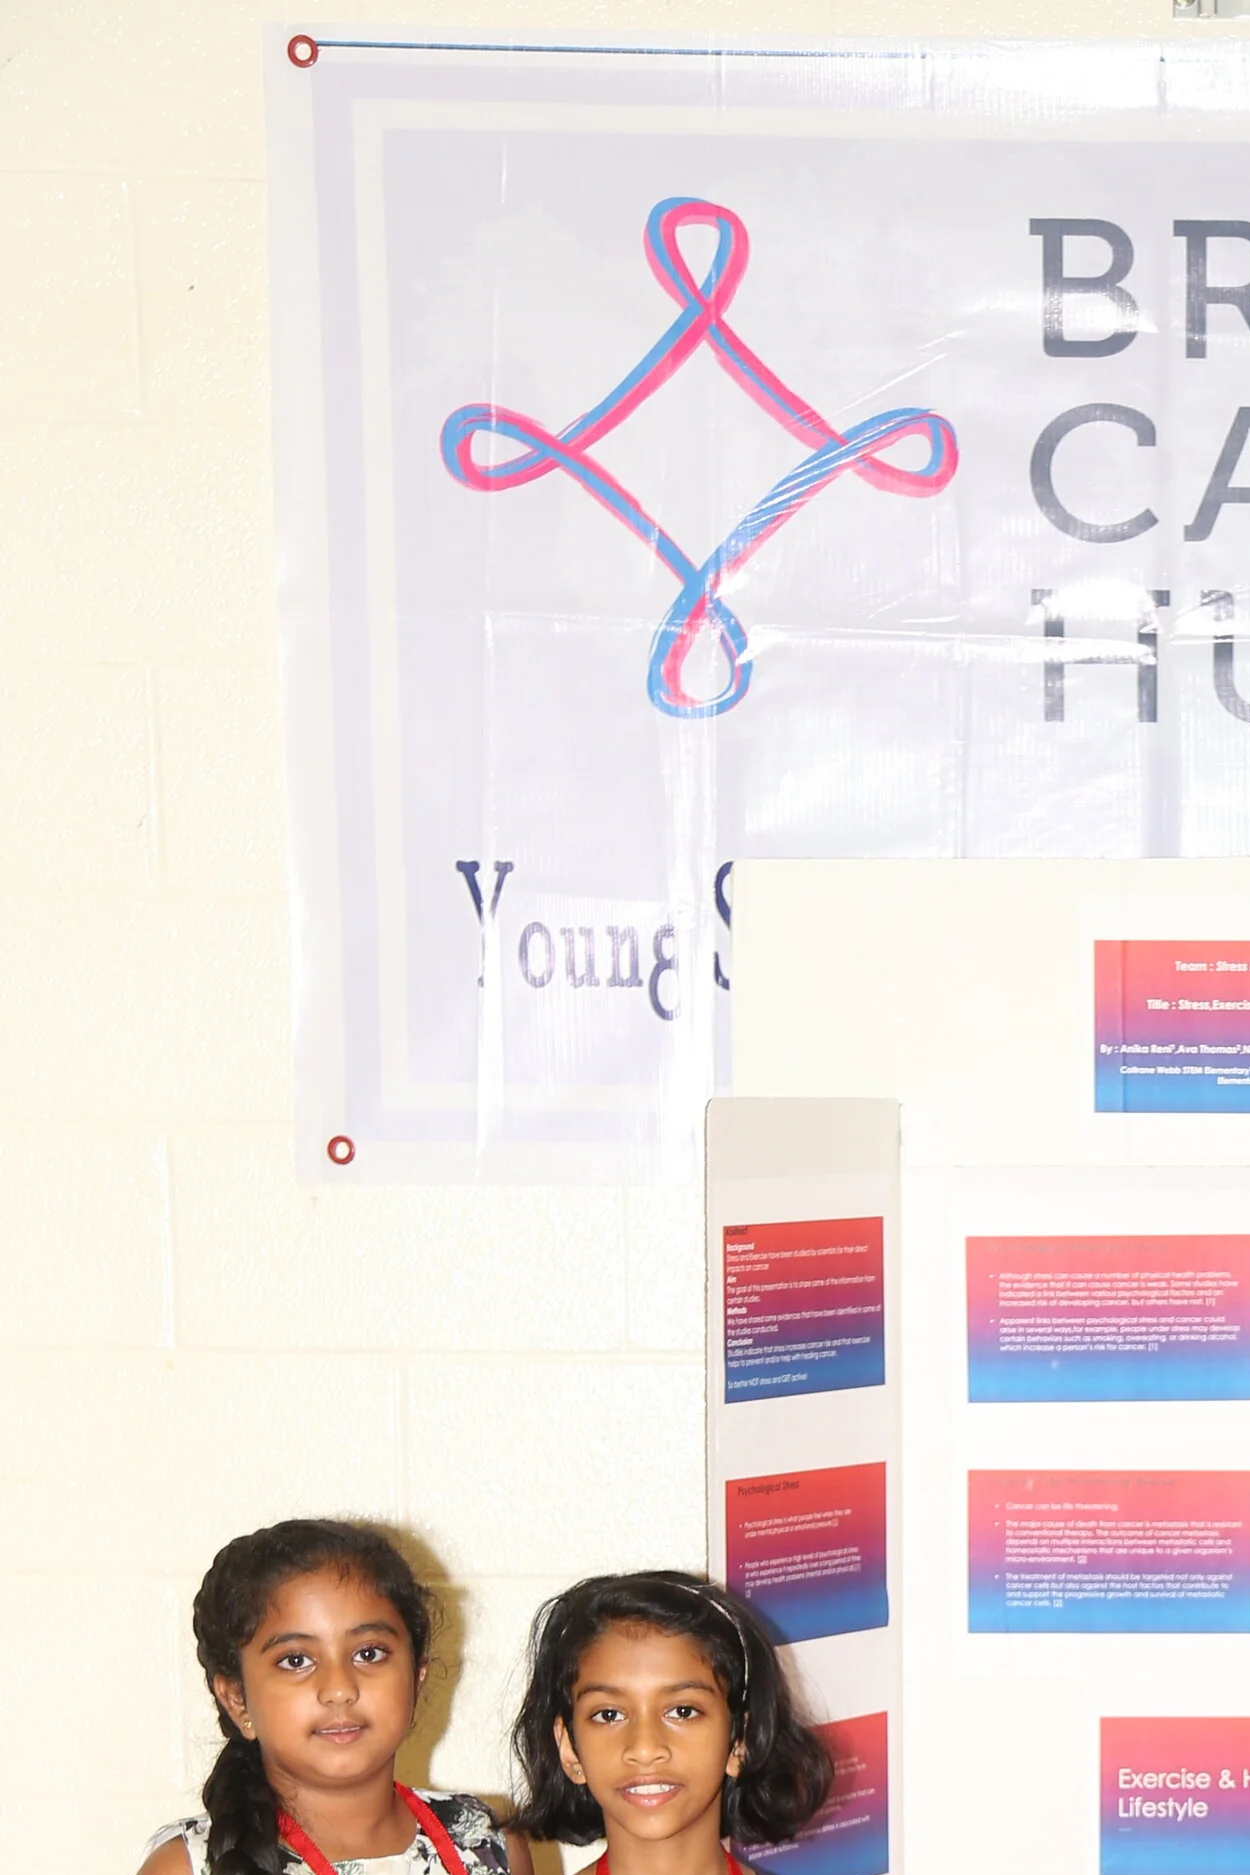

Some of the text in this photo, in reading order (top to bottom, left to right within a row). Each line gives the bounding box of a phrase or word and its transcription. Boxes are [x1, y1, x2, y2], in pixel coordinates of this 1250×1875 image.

[456, 861, 681, 1020] Young
[1175, 961, 1208, 972] Team
[1216, 961, 1248, 972] Stress
[1147, 999, 1170, 1010] Title
[1100, 1044, 1113, 1055] By
[1120, 1044, 1149, 1054] Anika
[1000, 1317, 1035, 1326] Apparent
[1052, 1316, 1086, 1324] between
[1086, 1316, 1137, 1325] psychological
[1119, 1325, 1147, 1334] people
[1191, 1326, 1207, 1334] may
[1208, 1325, 1240, 1334] develop
[1000, 1335, 1025, 1343] certain
[1178, 1334, 1207, 1343] drinking
[738, 1480, 800, 1496] Psychological Stress
[1005, 1502, 1033, 1510] Cancer
[1118, 1768, 1211, 1790] Exercise
[1218, 1769, 1237, 1790] &
[1118, 1797, 1210, 1822] Lifestyle
